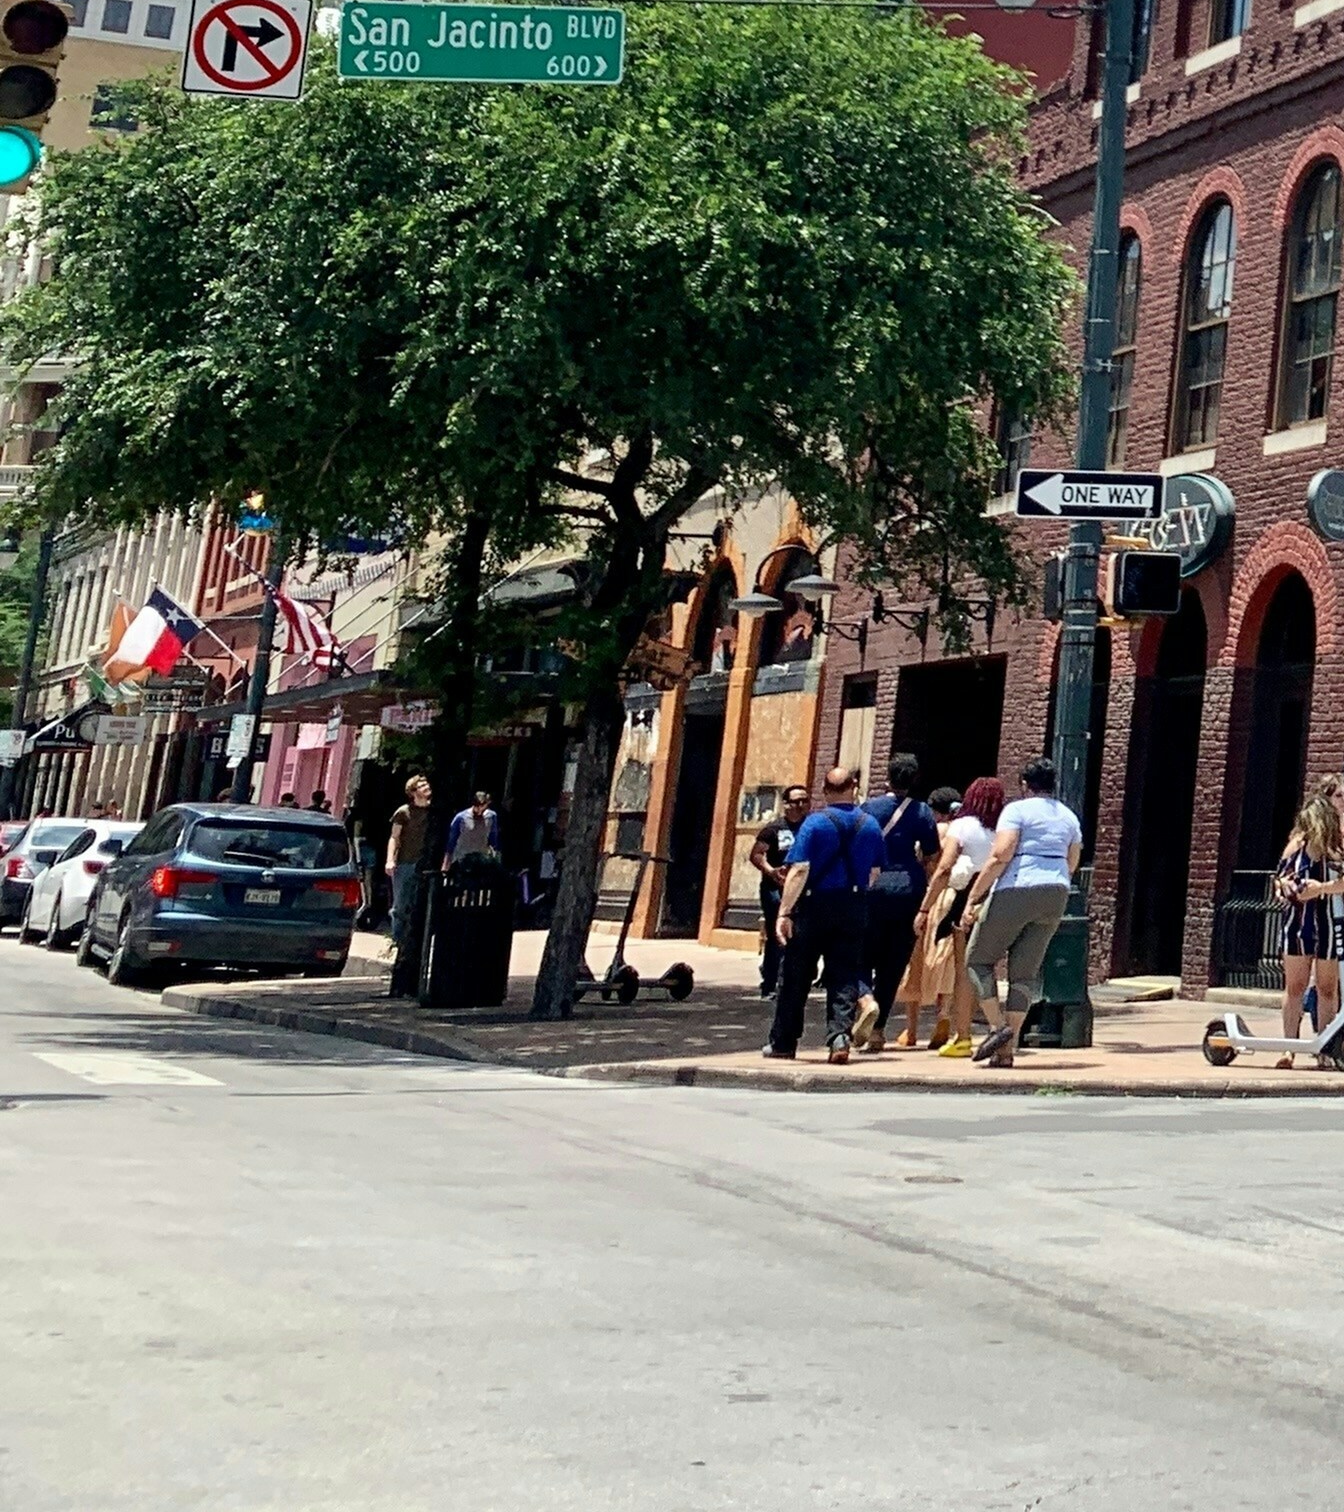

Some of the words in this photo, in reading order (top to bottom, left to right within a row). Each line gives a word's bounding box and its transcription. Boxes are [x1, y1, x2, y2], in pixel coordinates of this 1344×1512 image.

[348, 8, 410, 47] San
[427, 11, 553, 51] Jacinto
[567, 15, 617, 39] BLVD
[373, 51, 421, 73] 500
[546, 55, 591, 77] 600
[1061, 486, 1099, 503] ONE
[1107, 486, 1149, 504] WAY
